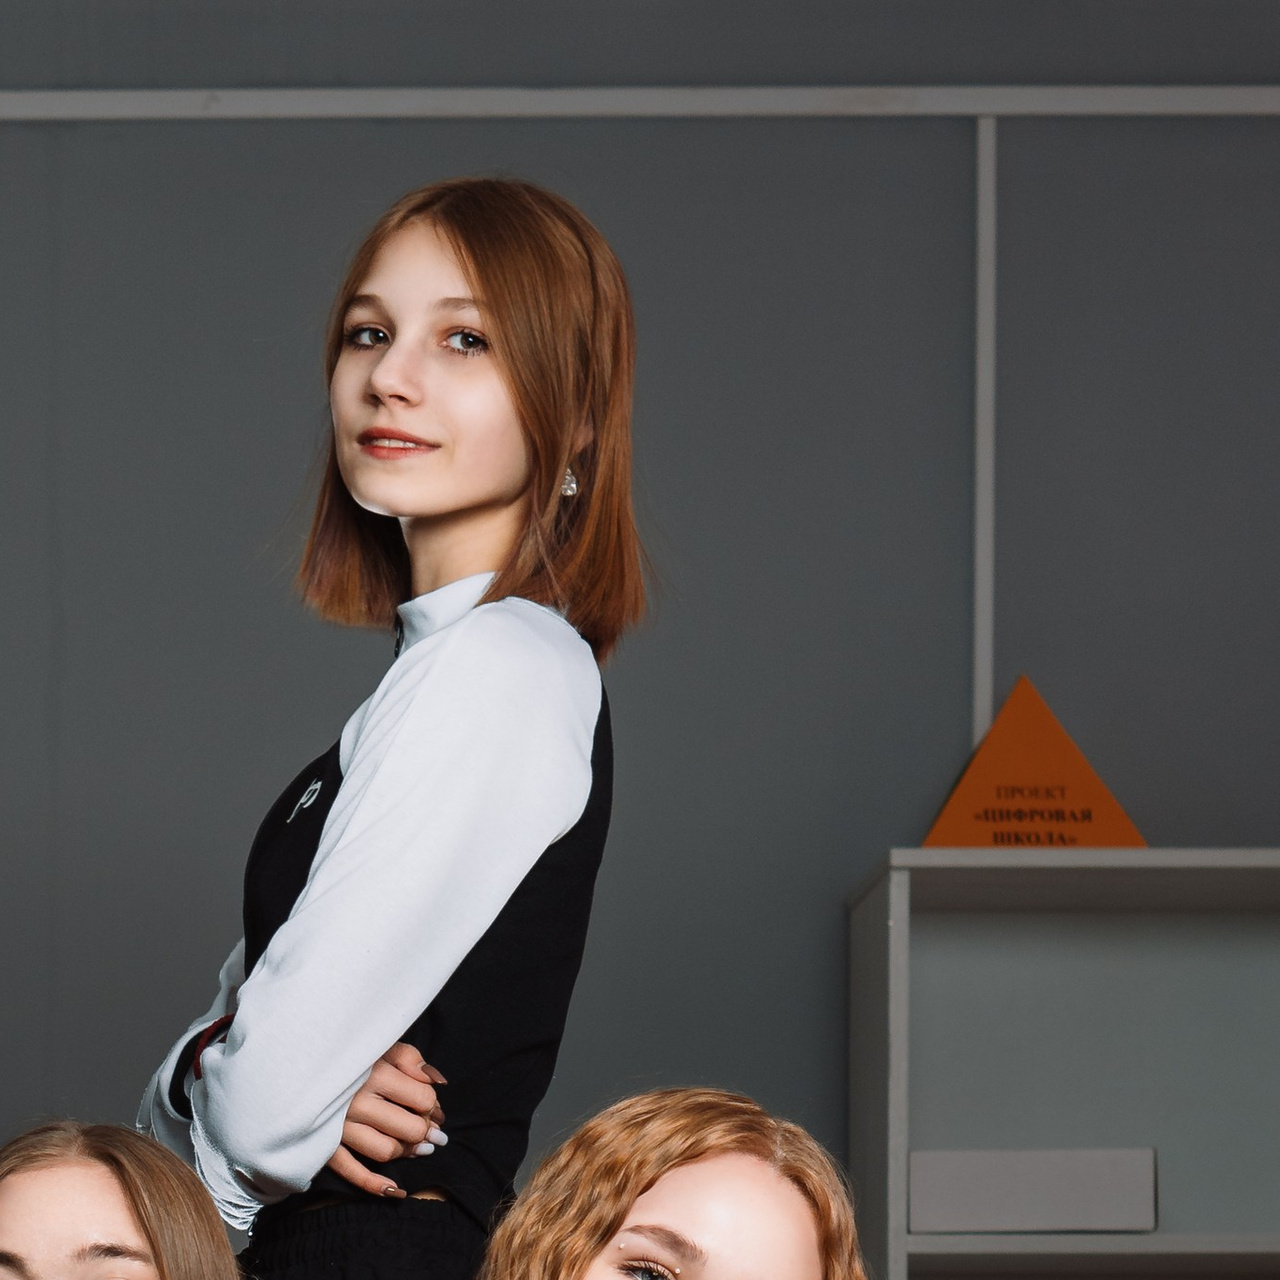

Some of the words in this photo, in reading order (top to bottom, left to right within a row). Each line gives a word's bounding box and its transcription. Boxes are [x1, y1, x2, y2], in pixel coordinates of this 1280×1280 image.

[996, 786, 1066, 800] ПРОЕКТ
[974, 808, 1092, 823] «ЦИФРОВАЯ
[992, 831, 1077, 846] ШКОЛА»
